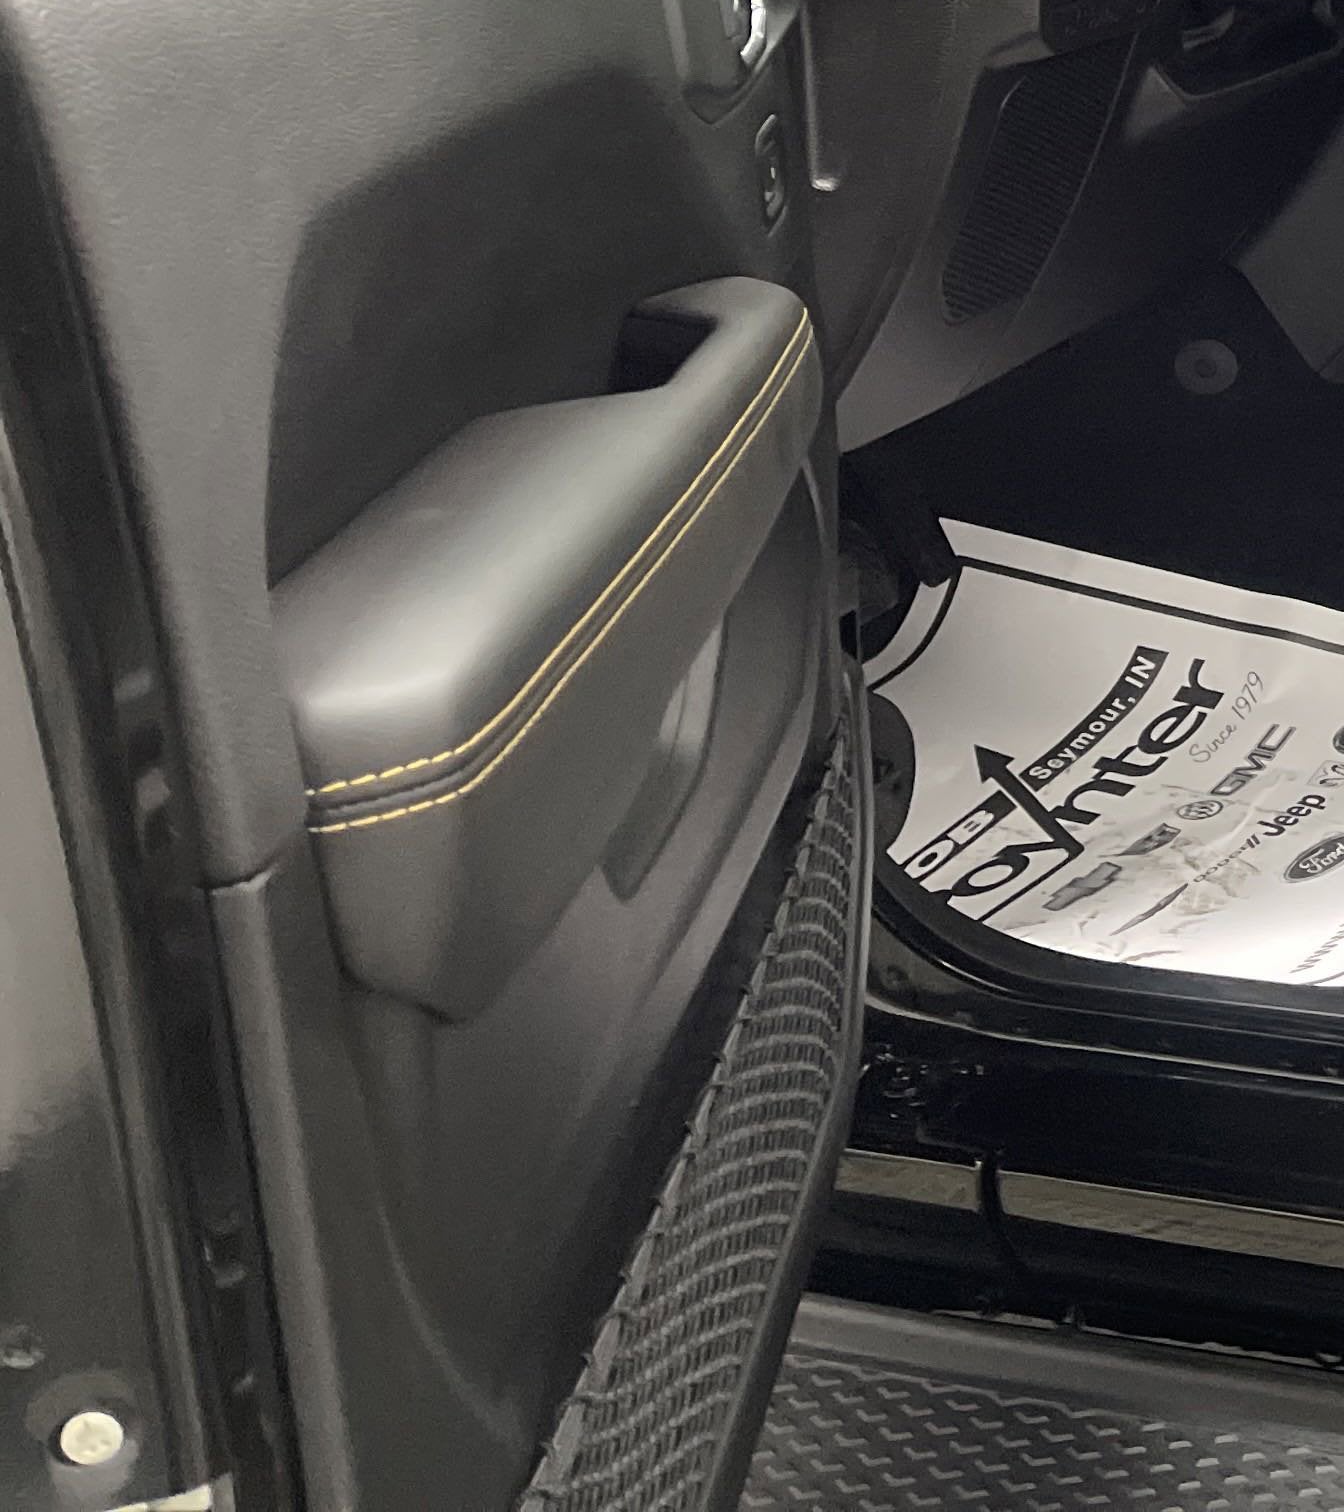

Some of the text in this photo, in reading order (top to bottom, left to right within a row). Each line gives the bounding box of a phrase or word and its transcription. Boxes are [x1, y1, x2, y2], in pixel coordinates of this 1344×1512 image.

[1028, 655, 1157, 781] Seymour, IN
[1188, 670, 1265, 764] Since 1979
[928, 657, 1226, 922] oynter
[1209, 723, 1298, 797] GMC
[903, 809, 996, 880] OB
[1256, 793, 1327, 838] Jeep
